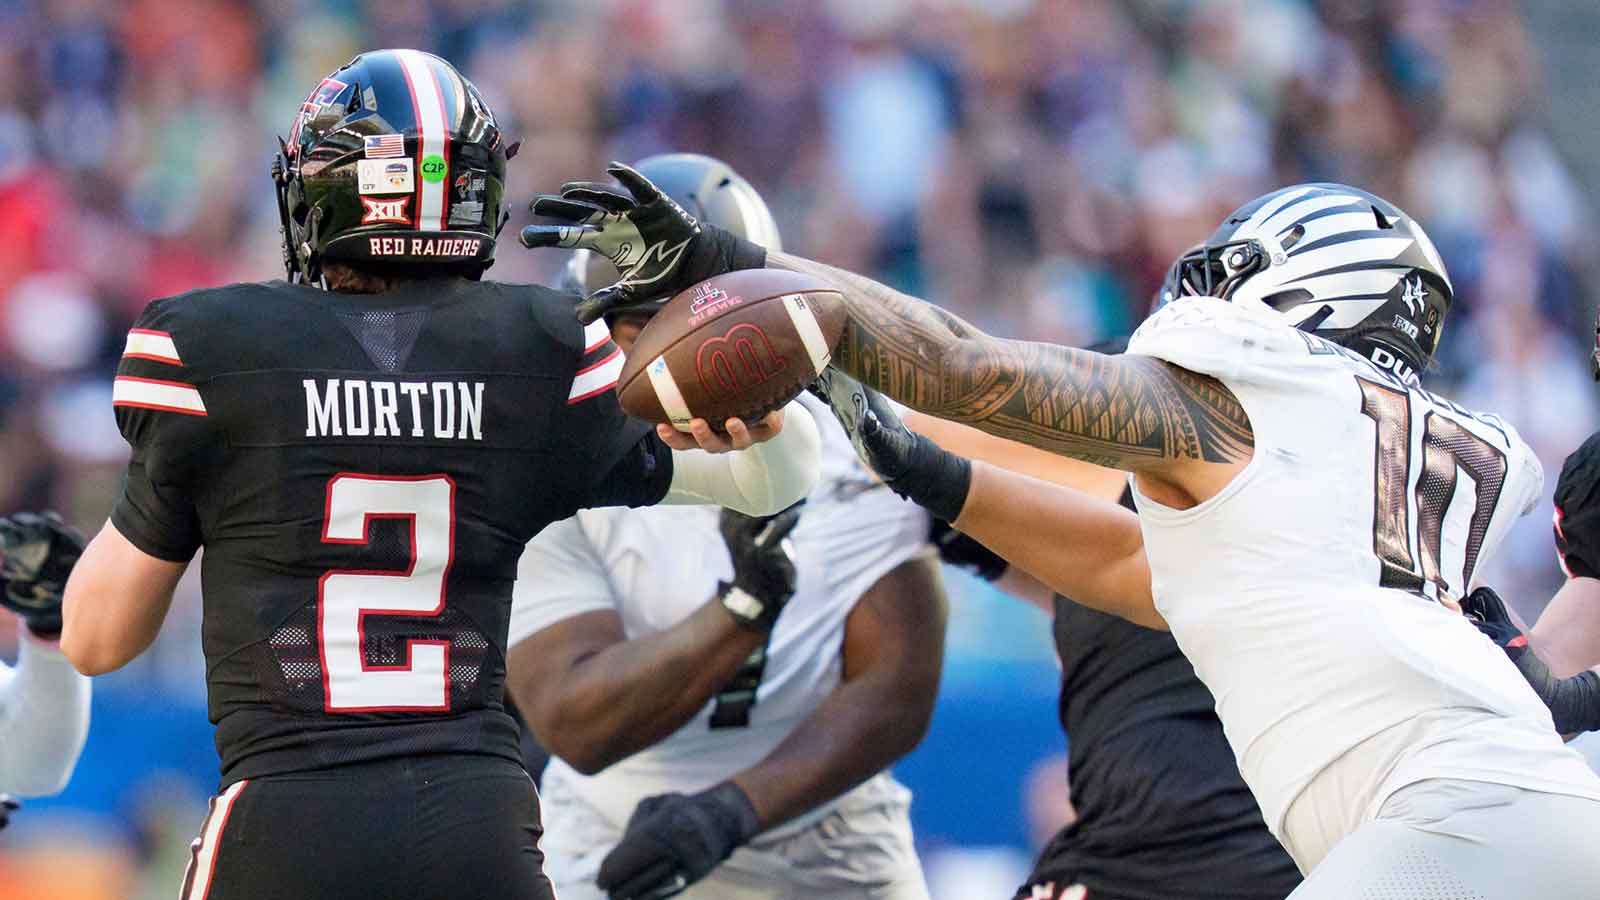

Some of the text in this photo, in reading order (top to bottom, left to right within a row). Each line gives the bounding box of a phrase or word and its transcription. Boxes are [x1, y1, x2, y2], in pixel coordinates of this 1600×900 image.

[422, 162, 445, 174] C2P
[369, 238, 480, 257] RED RAIDERS
[302, 379, 485, 441] MORTON
[1354, 374, 1508, 615] 10
[317, 472, 456, 713] 2
